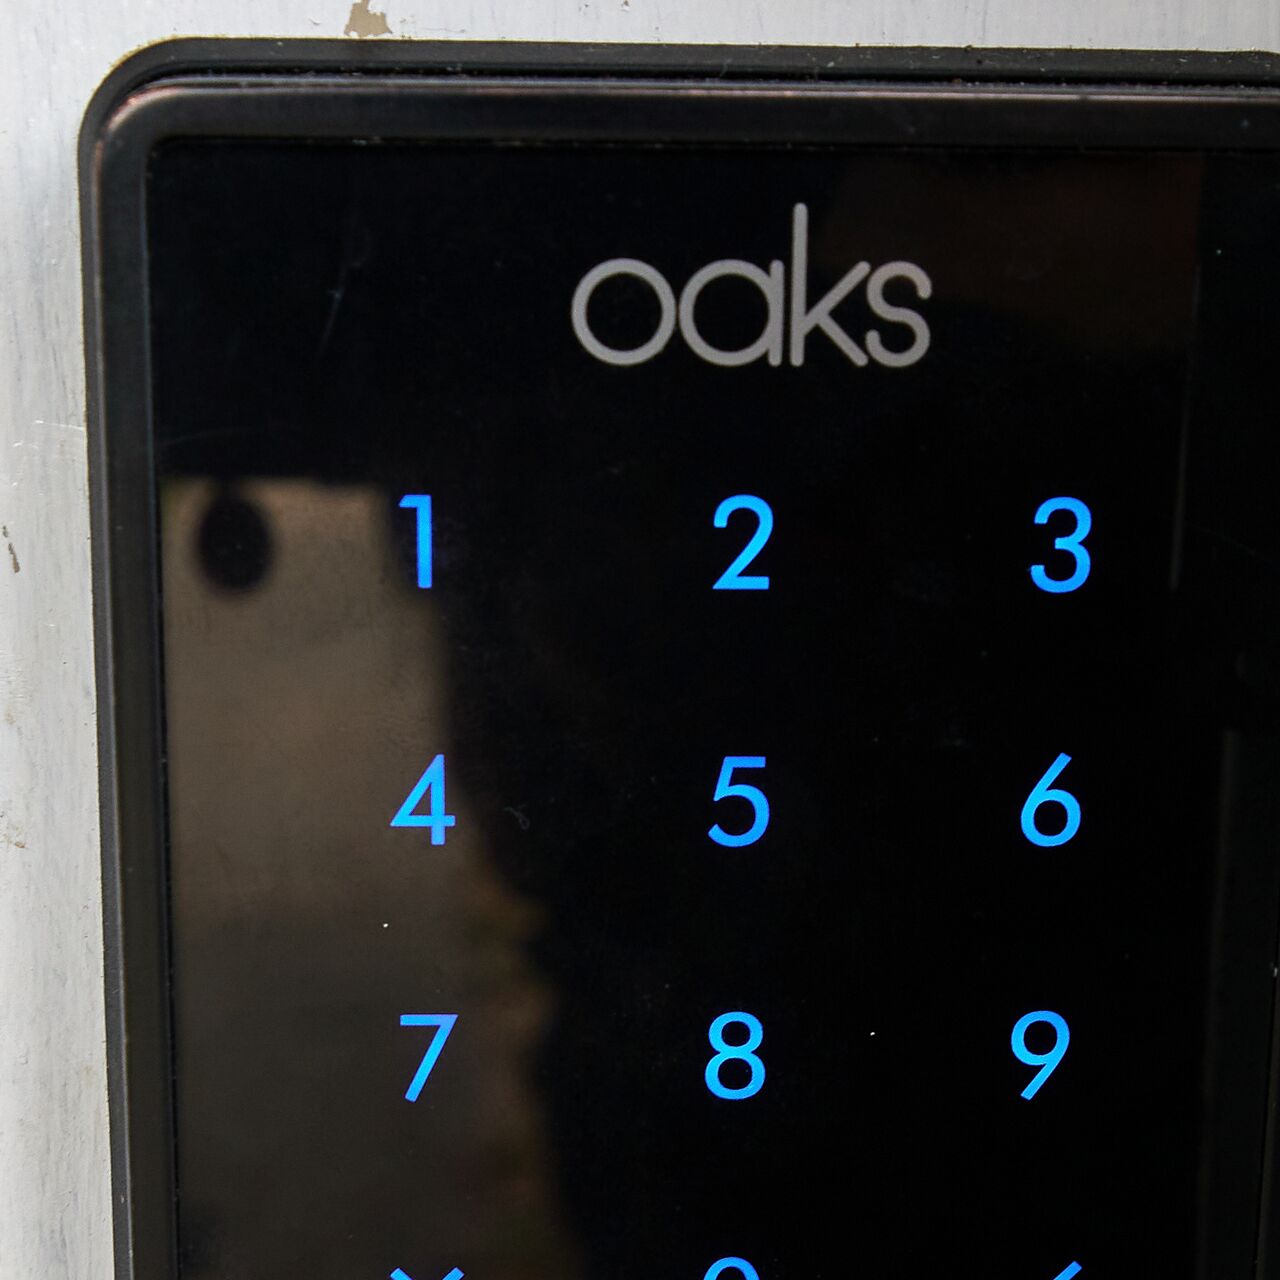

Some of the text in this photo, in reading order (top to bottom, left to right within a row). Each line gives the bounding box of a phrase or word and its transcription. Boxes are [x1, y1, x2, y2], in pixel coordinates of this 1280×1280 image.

[570, 202, 933, 368] oaks
[398, 493, 1093, 594] 1 2 3
[390, 752, 1082, 848] 4 5 6
[399, 1010, 1071, 1102] 7 8 9
